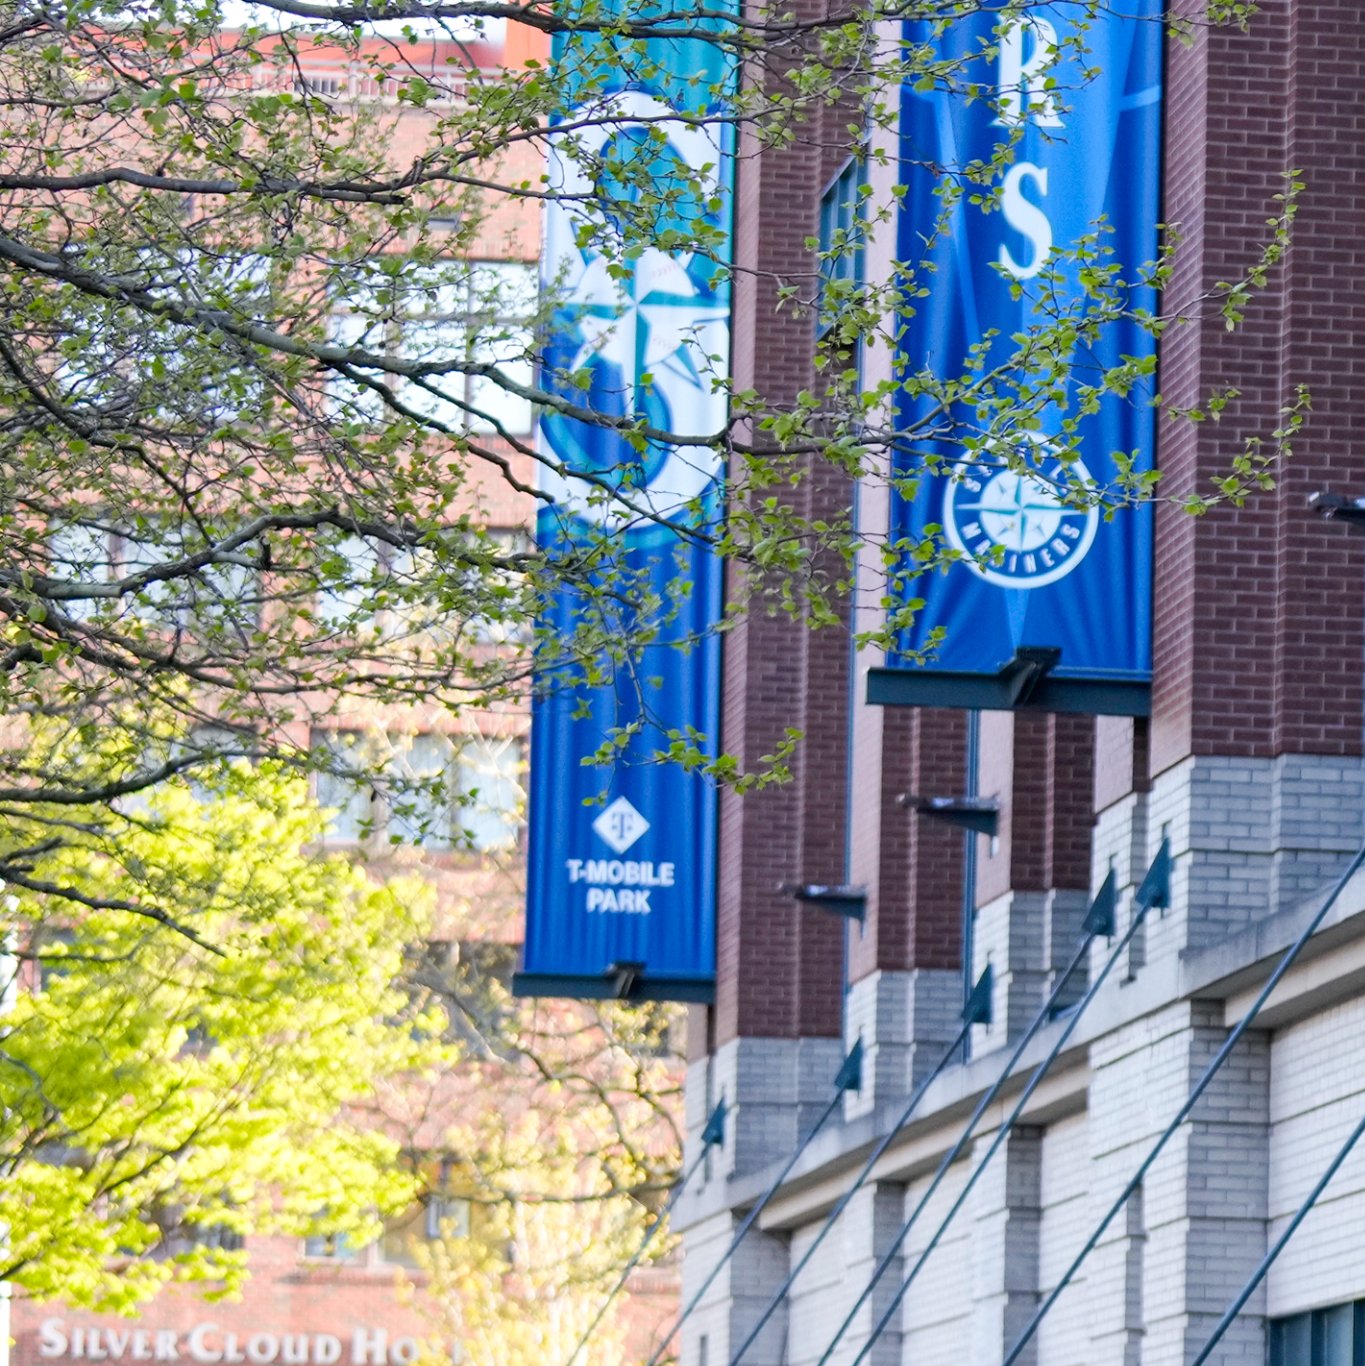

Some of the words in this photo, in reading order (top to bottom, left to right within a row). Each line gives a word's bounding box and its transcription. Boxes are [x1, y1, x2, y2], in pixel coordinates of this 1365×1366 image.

[960, 522, 1080, 574] MAINERS
[565, 858, 675, 887] T-MOBILE
[586, 887, 652, 916] PARK
[39, 1317, 180, 1361] SILVER
[188, 1323, 342, 1365] CLOUD
